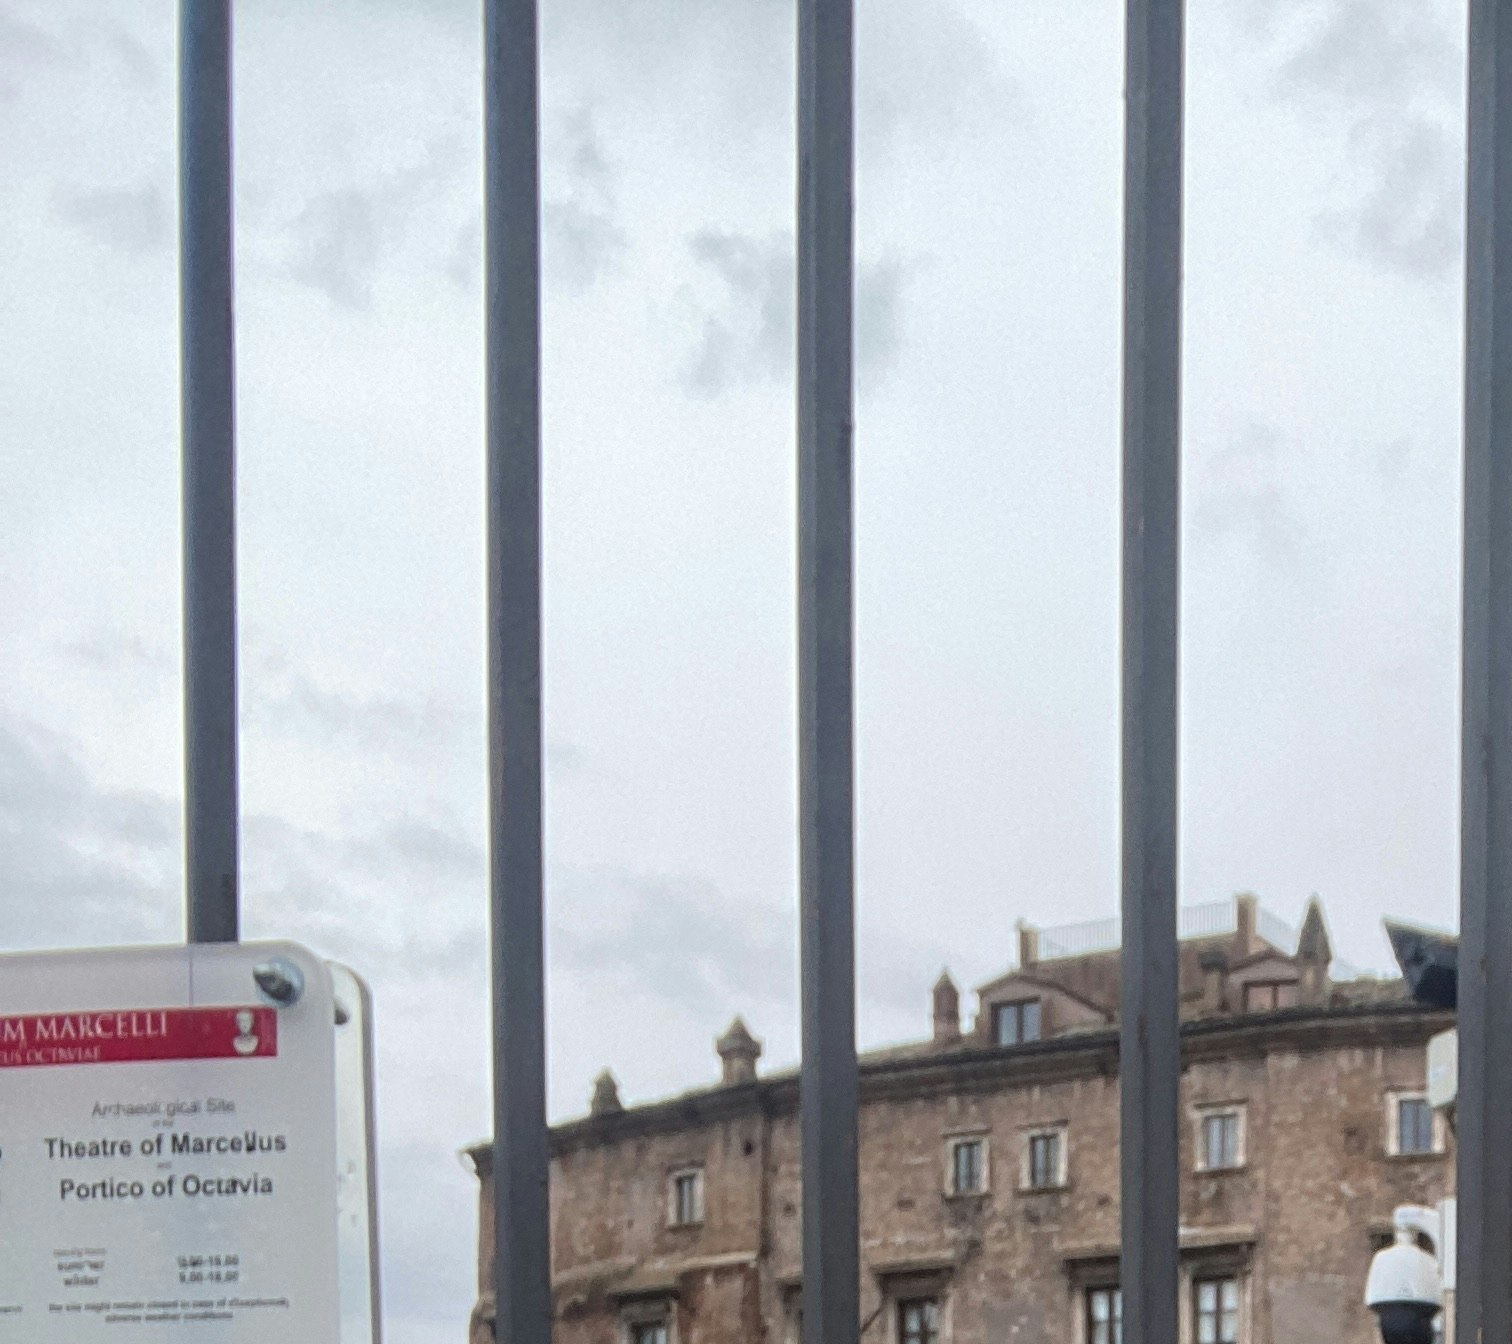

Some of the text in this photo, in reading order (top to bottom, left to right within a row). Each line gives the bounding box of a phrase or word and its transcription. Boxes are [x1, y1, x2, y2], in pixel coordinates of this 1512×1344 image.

[36, 1011, 167, 1041] MARCELLI
[44, 1130, 287, 1158] Theatre of Marcellus
[60, 1172, 273, 1199] Portico of Octavia
